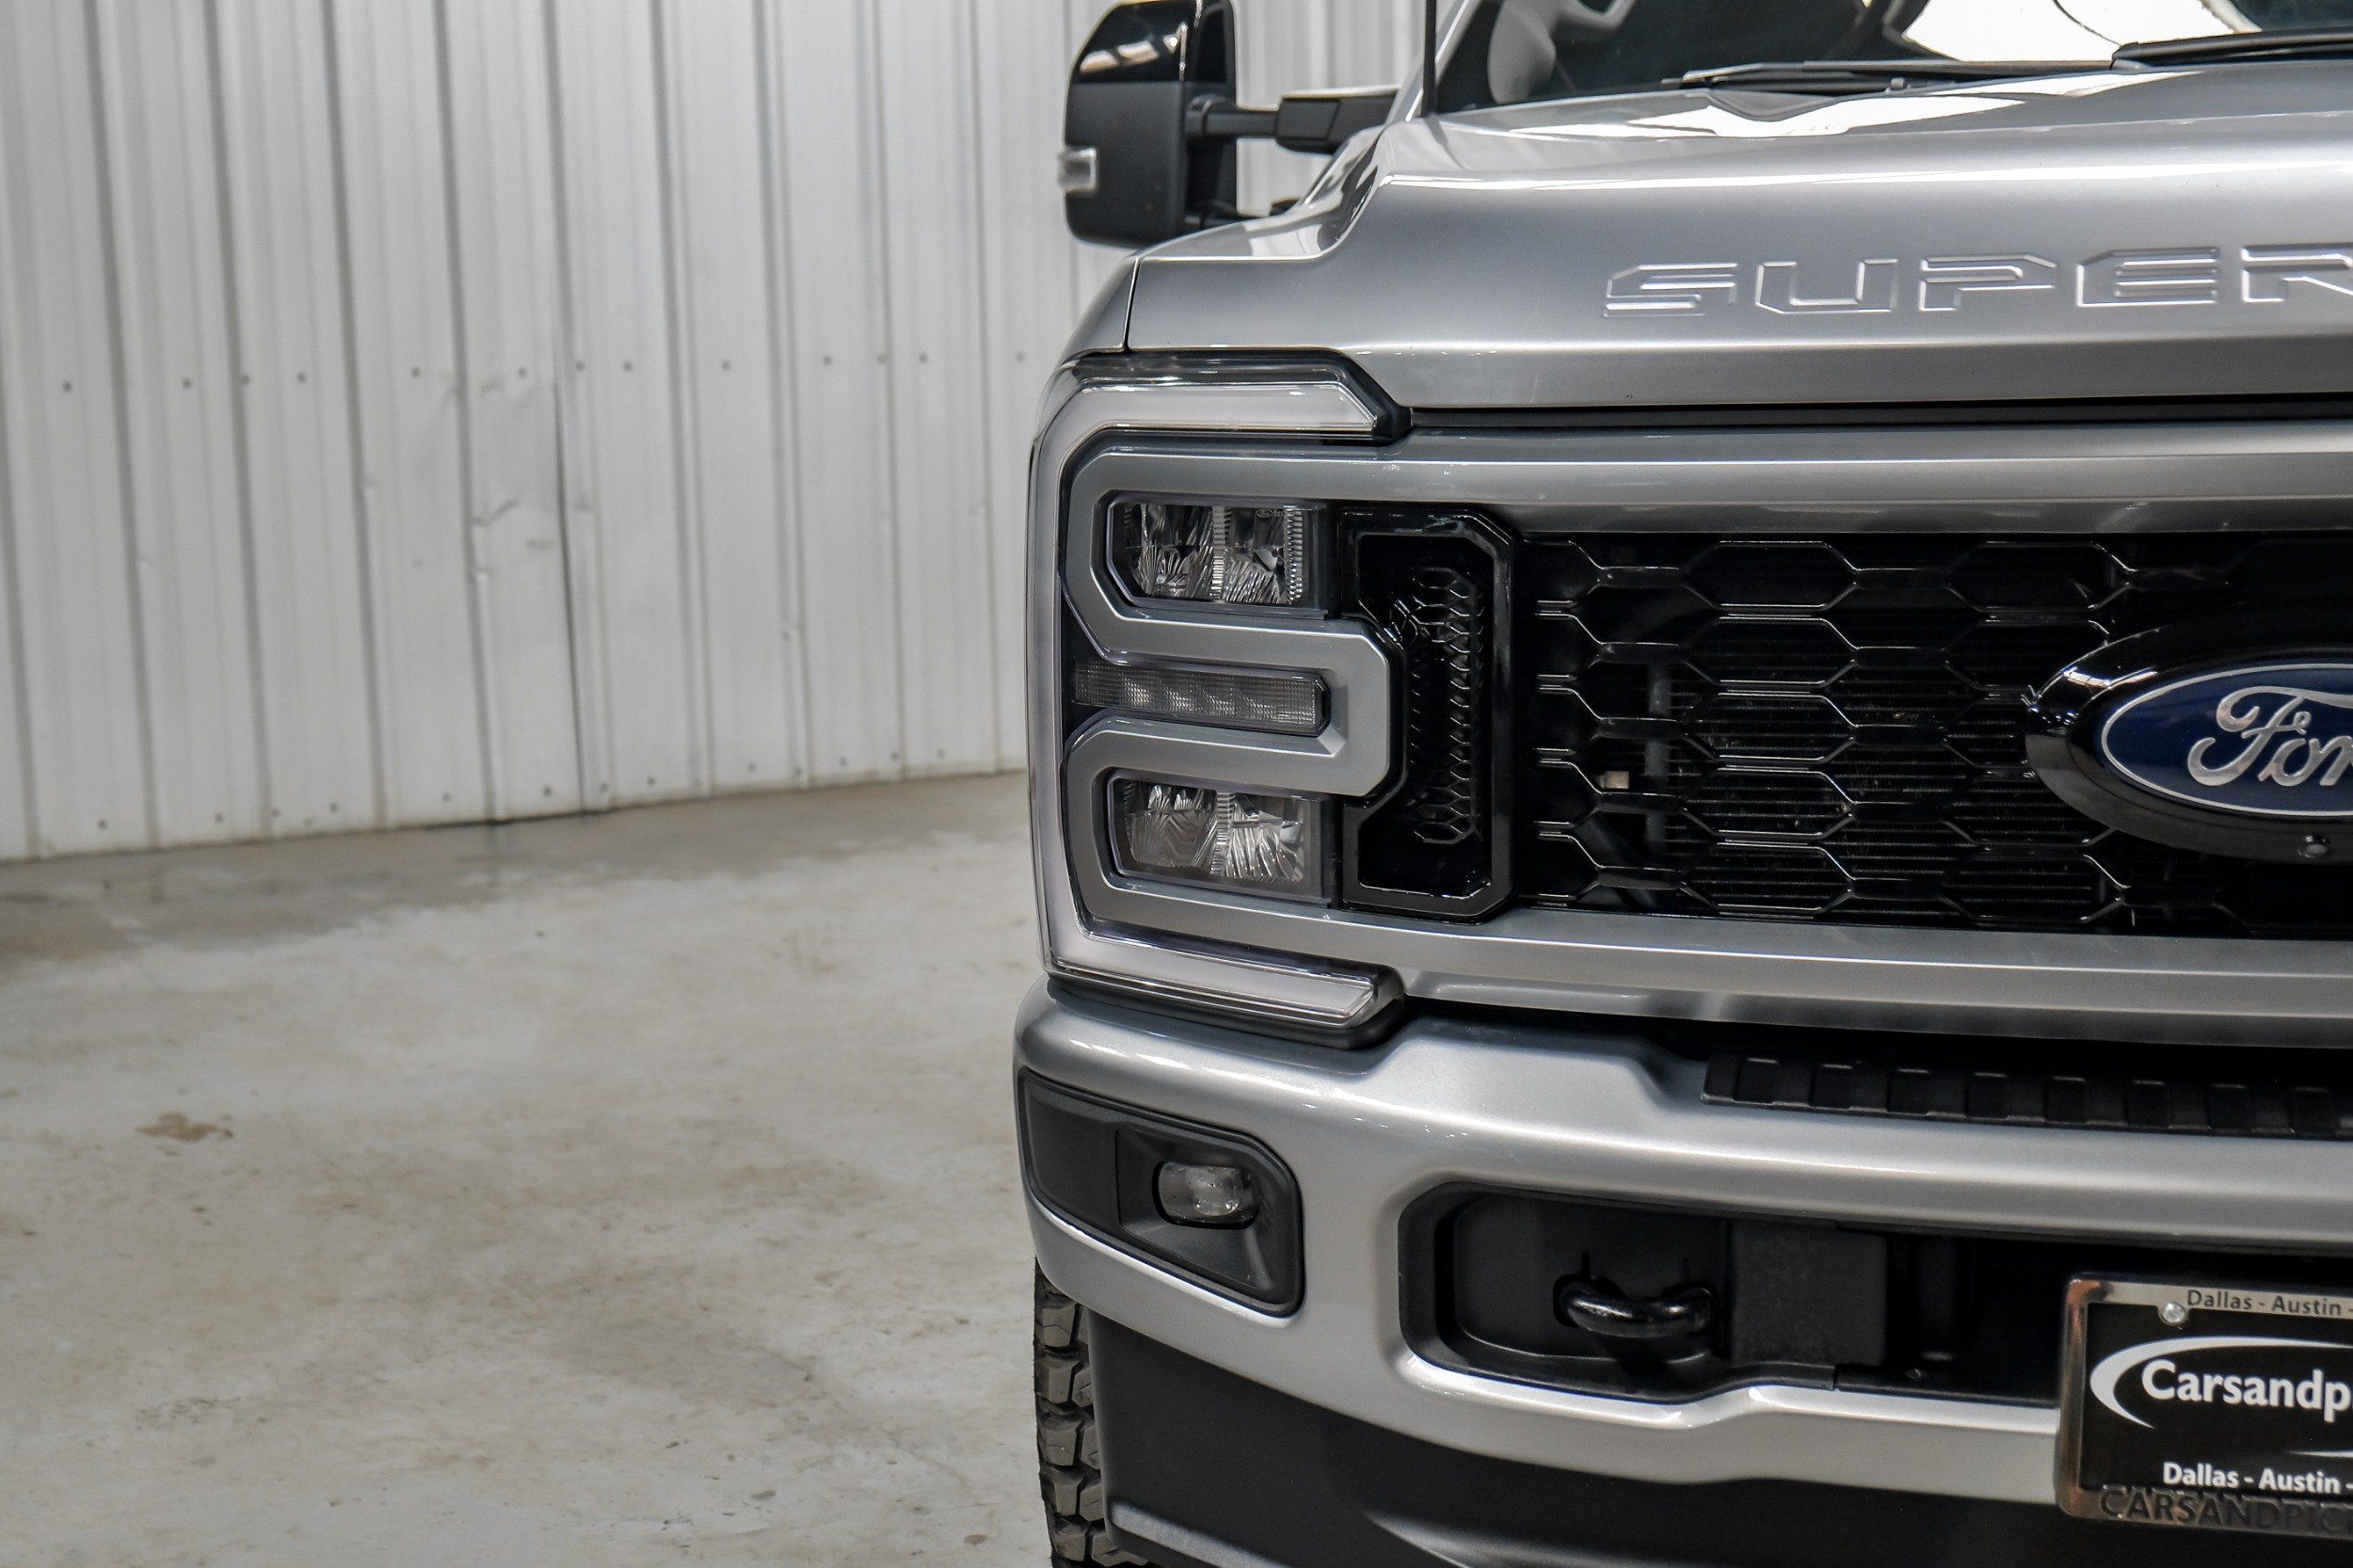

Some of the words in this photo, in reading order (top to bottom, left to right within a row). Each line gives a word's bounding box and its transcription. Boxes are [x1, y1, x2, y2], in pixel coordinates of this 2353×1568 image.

[1603, 243, 2353, 318] SUPER
[2186, 1289, 2252, 1310] Dallas
[2271, 1295, 2342, 1317] Austin
[2141, 1359, 2352, 1423] Carsandp
[2163, 1461, 2239, 1489] Dallas
[2259, 1467, 2341, 1495] Austin
